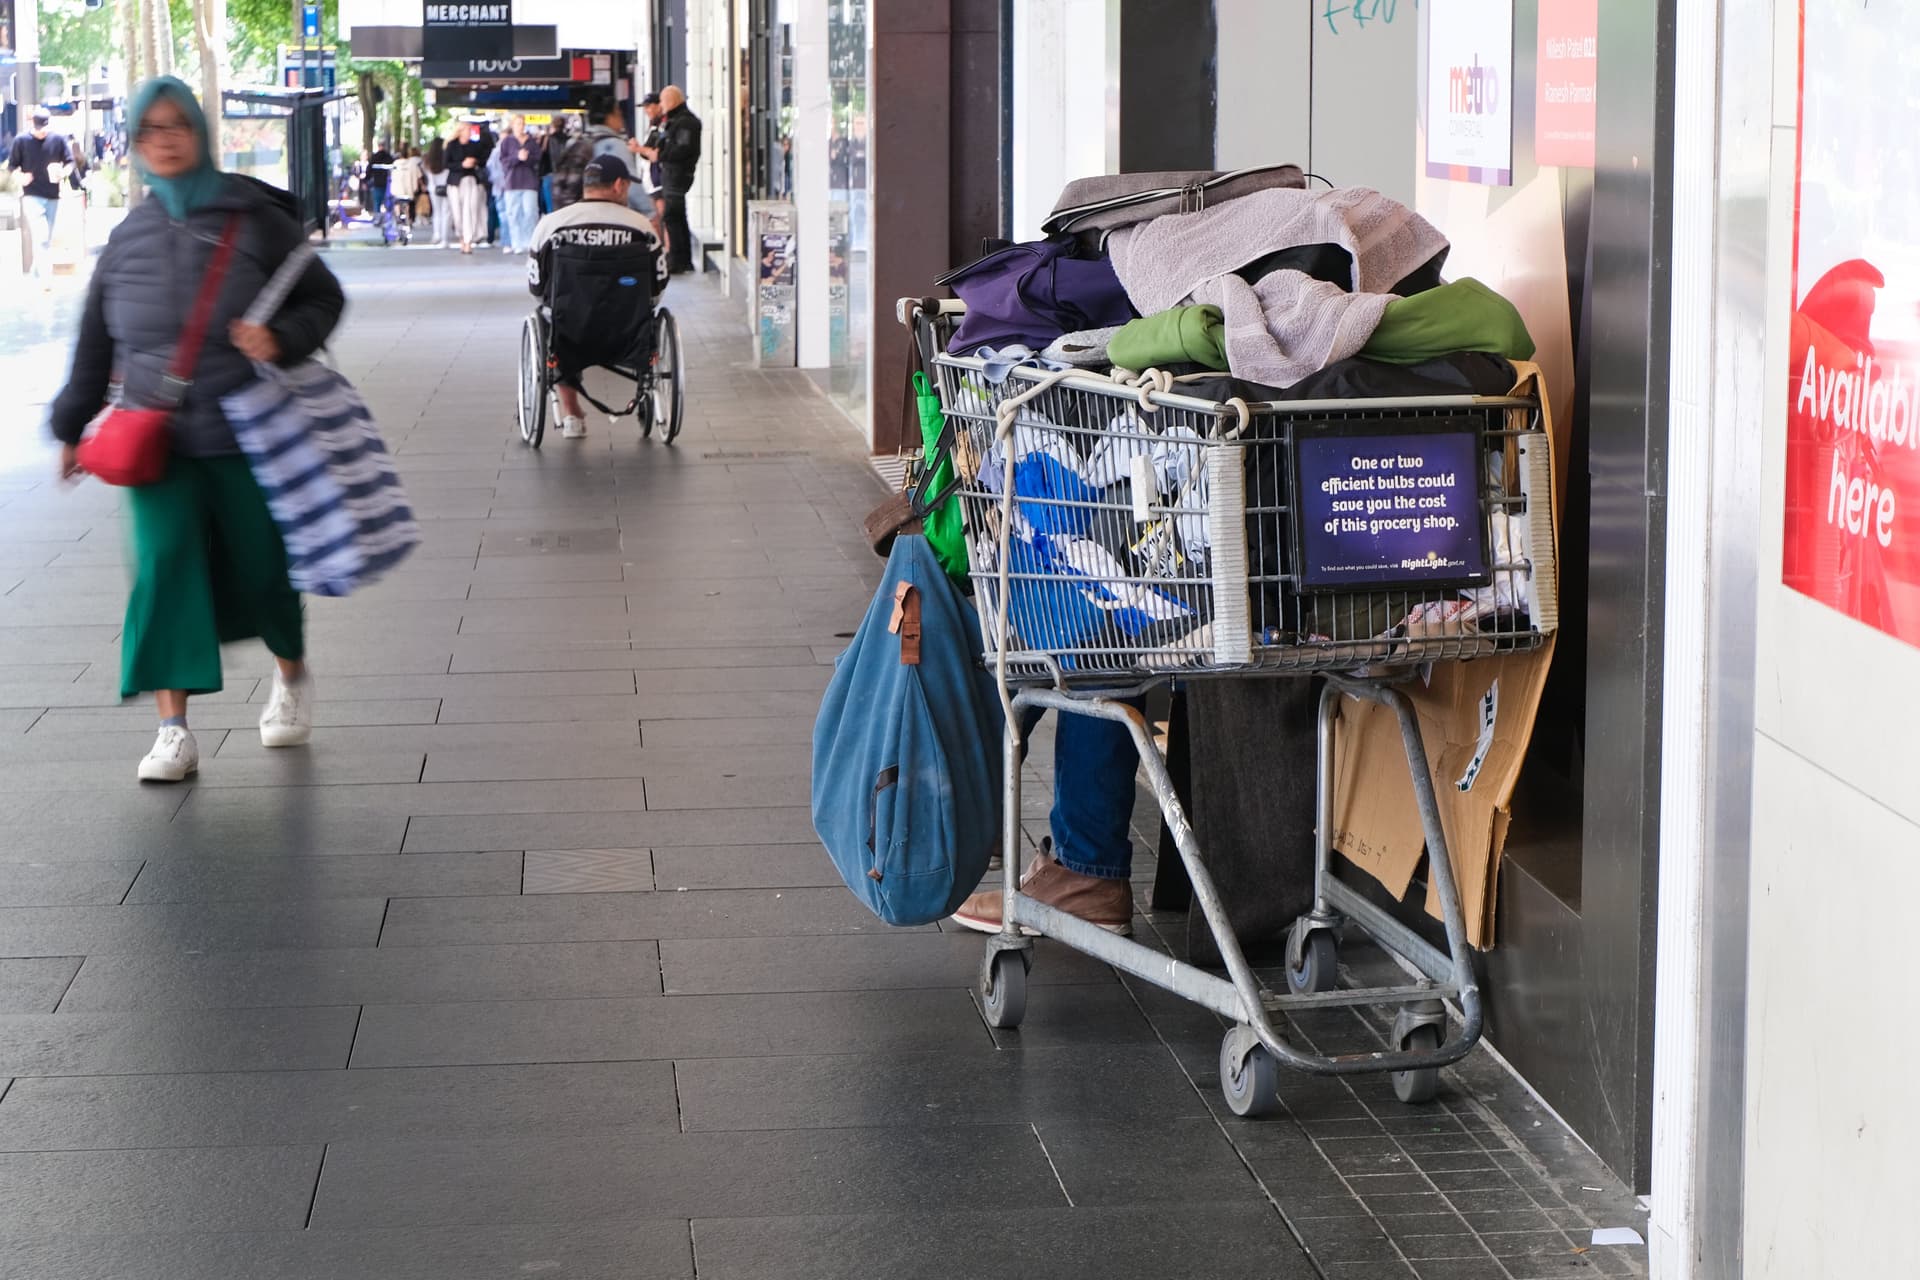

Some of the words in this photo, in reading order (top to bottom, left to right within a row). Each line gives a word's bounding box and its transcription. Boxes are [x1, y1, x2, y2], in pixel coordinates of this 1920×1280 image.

[426, 4, 508, 21] MERCHANT
[1450, 53, 1499, 114] metro
[1797, 345, 1920, 449] Availabl
[1351, 457, 1378, 470] One
[1380, 457, 1395, 469] or
[1397, 455, 1423, 468] two
[1321, 476, 1375, 495] efficient
[1377, 475, 1415, 490] bulbs
[1417, 473, 1455, 488] could
[1332, 499, 1364, 512] save
[1366, 498, 1391, 515] you
[1394, 495, 1416, 509] the
[1418, 494, 1447, 508] cost
[1828, 449, 1896, 548] here
[1324, 518, 1340, 536] of
[1341, 517, 1367, 532] this
[1370, 517, 1421, 535] grocery
[1423, 514, 1459, 531] shop.
